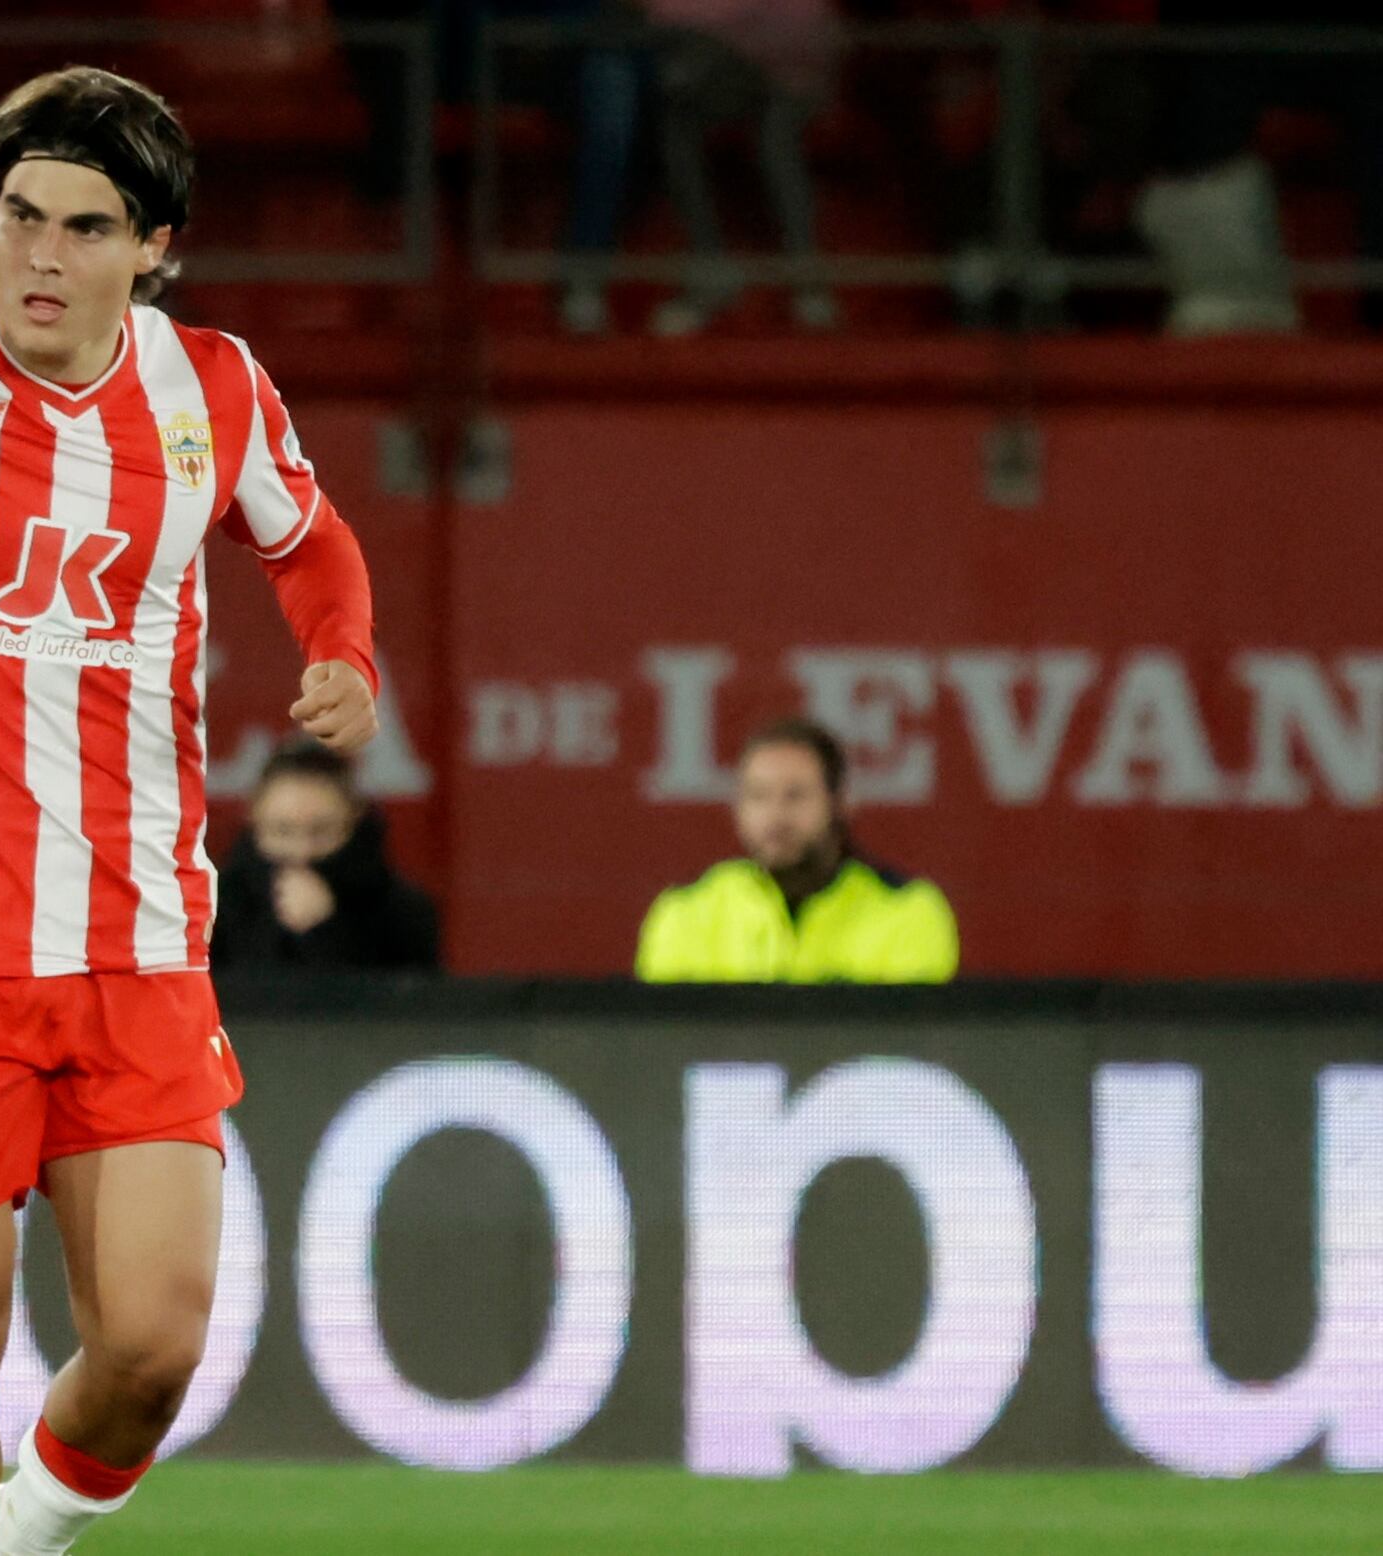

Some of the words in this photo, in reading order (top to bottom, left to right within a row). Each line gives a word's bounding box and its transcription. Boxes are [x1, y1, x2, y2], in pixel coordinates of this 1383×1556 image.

[36, 634, 101, 660] Juffali
[109, 644, 139, 664] Co.
[469, 679, 620, 768] DE
[641, 646, 1383, 807] LEVAN
